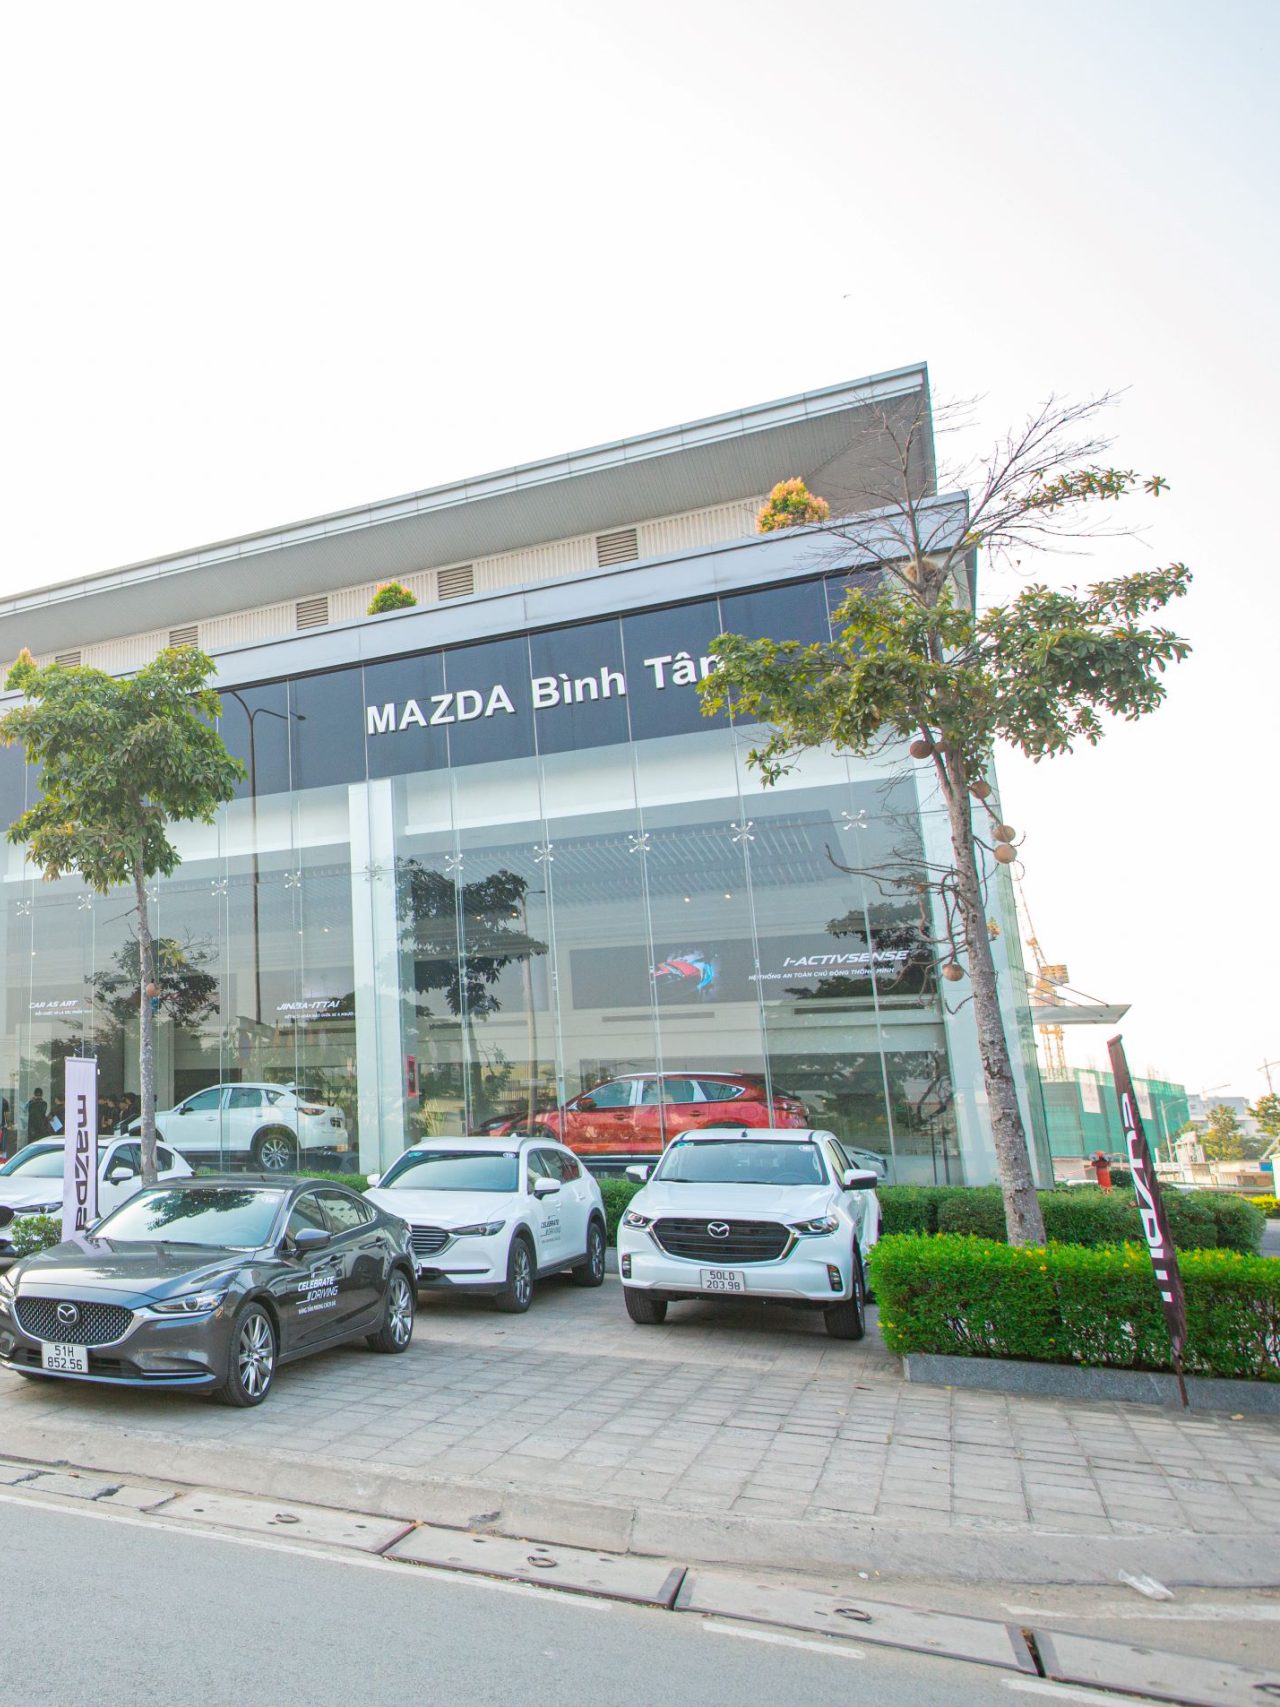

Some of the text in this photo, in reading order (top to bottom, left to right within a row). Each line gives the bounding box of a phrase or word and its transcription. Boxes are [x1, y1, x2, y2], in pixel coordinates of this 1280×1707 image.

[366, 684, 515, 735] MAZDA
[531, 666, 626, 709] Bình
[297, 1276, 335, 1292] CELEBRATE
[706, 1280, 741, 1291] 203.98
[54, 1345, 74, 1357] 51H
[47, 1356, 83, 1370] 852.56
